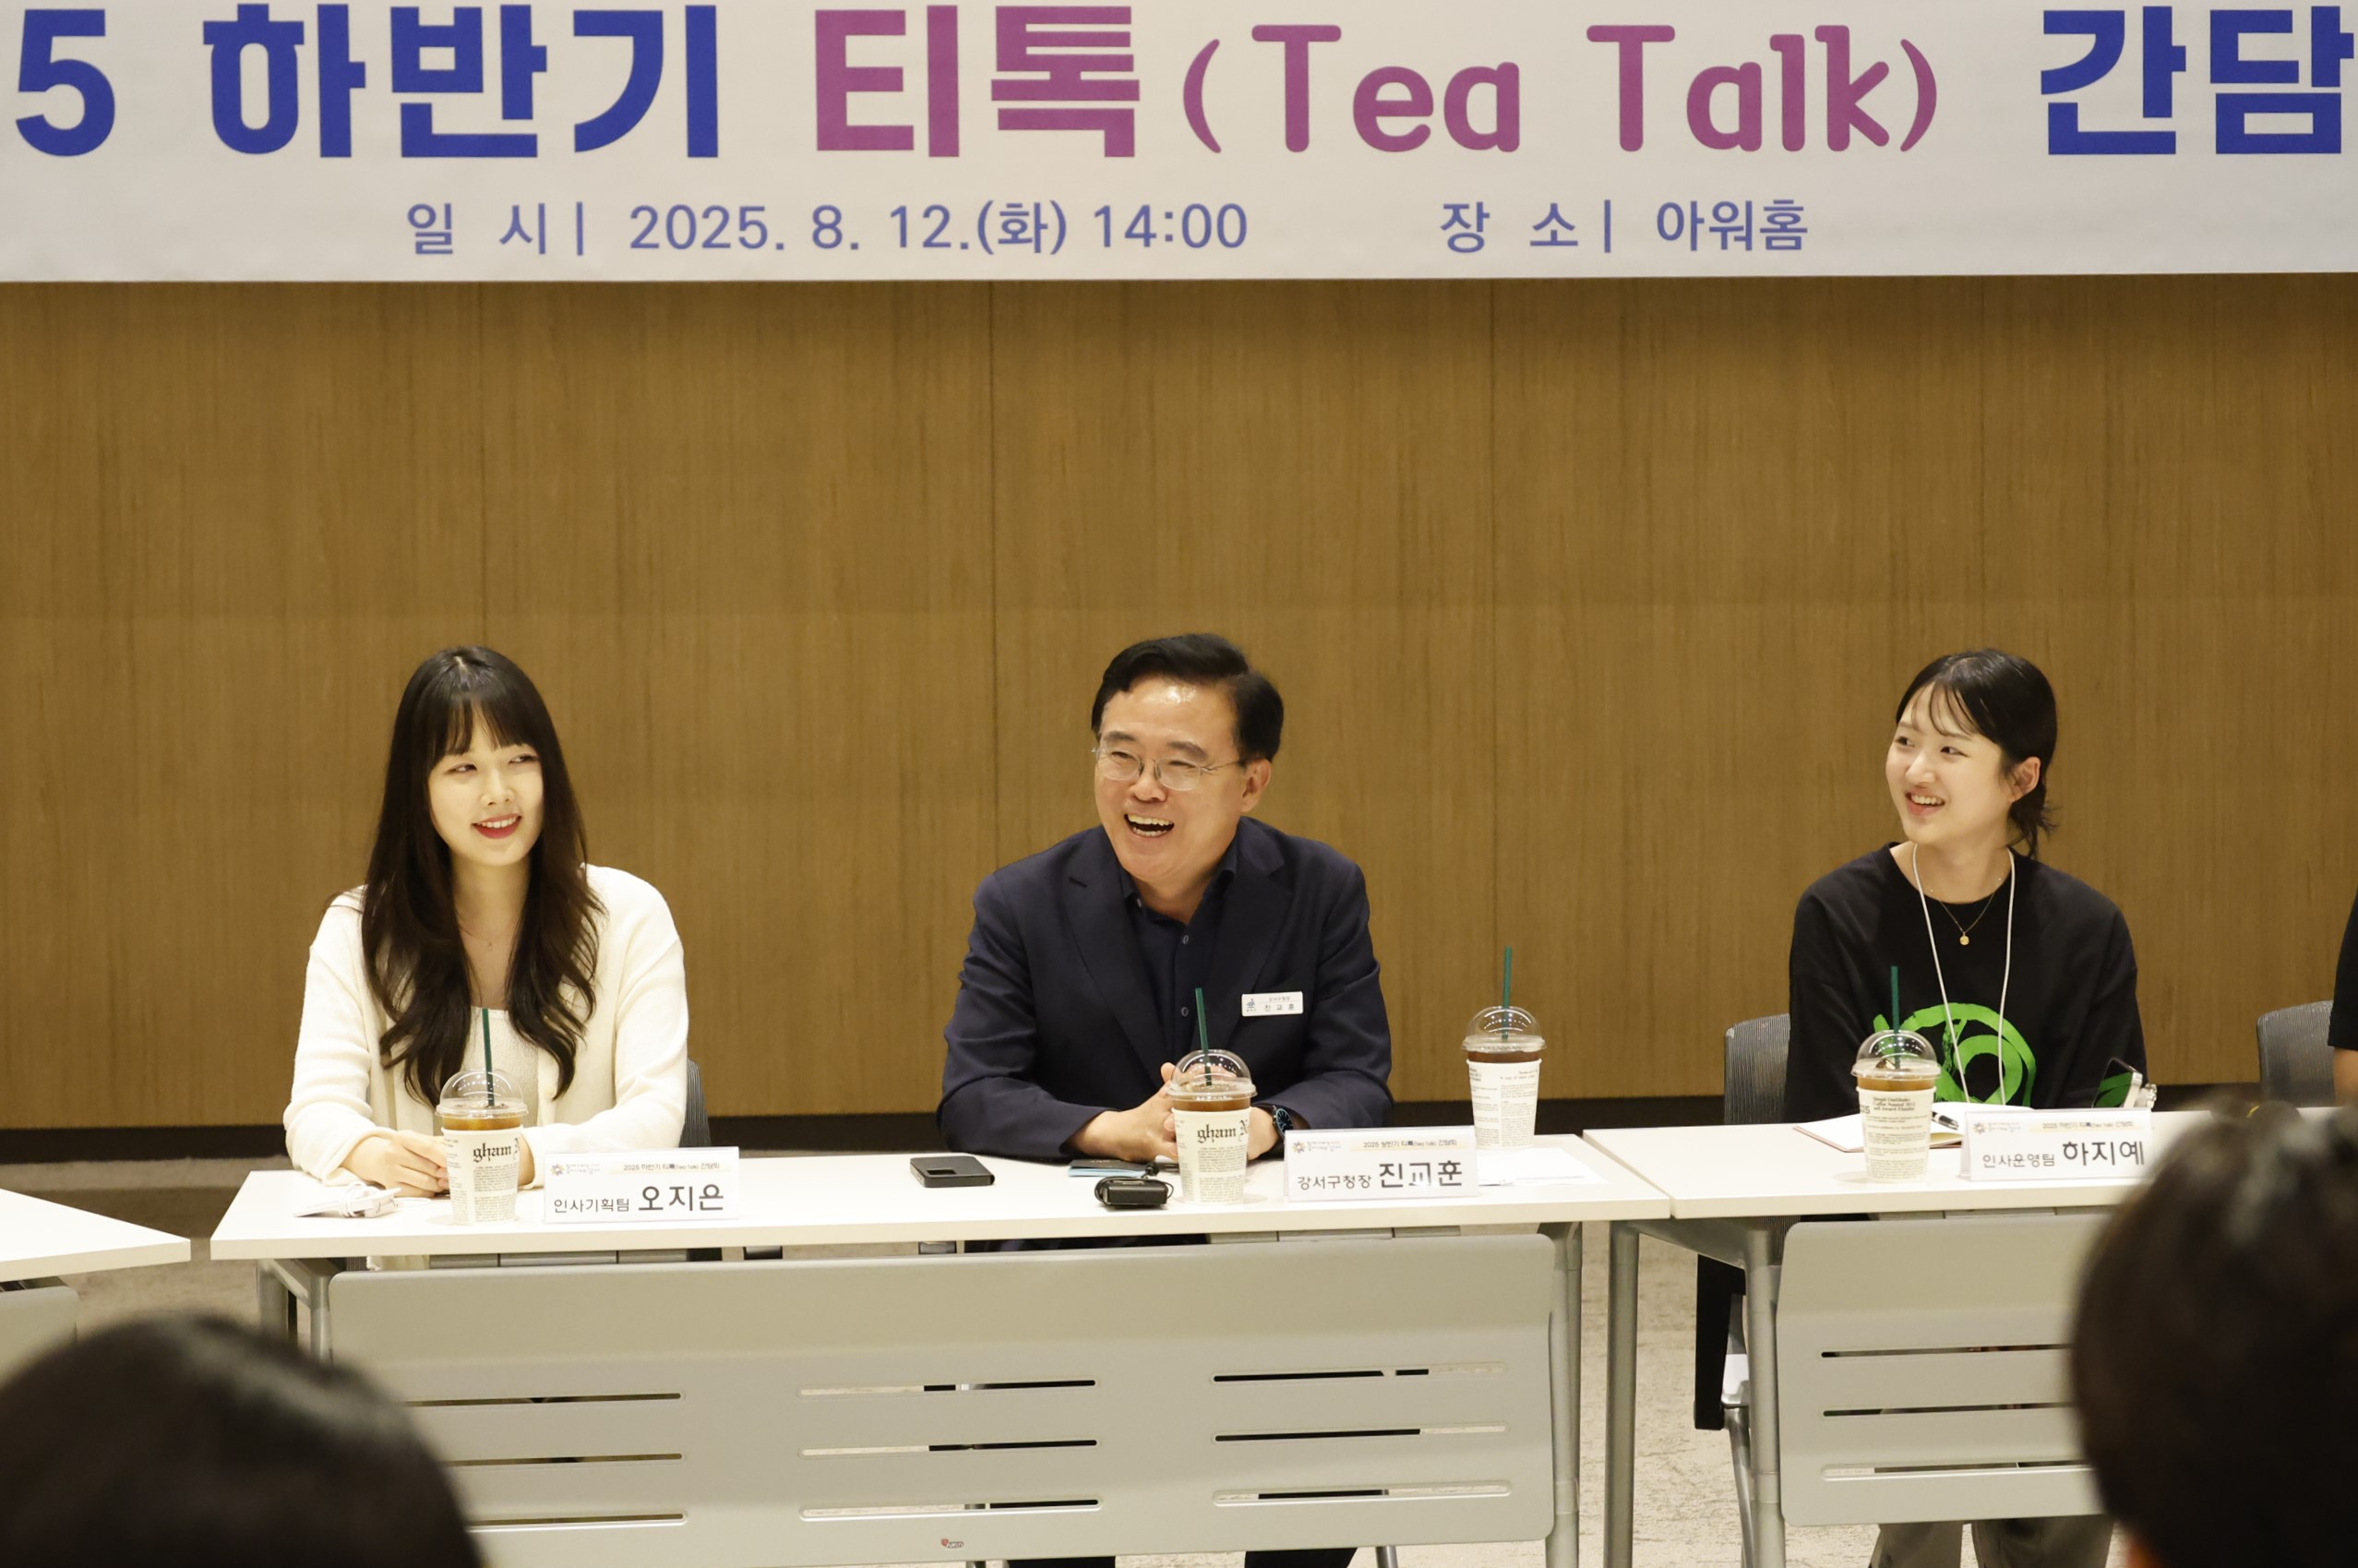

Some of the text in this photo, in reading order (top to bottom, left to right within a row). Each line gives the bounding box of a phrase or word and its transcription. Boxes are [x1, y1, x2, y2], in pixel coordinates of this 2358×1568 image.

[203, 4, 718, 158] 하반기
[1586, 25, 1936, 153] Talk)
[2041, 6, 2355, 155] 간담
[408, 204, 452, 254] 일
[631, 205, 784, 250] 2025.
[813, 205, 859, 250] 8.
[1095, 204, 1247, 249] 14:00
[1442, 202, 1490, 253] 장
[1658, 199, 1808, 251] 아워홈
[1982, 1142, 2145, 1168] 인사운영팀 하지예
[1298, 1160, 1463, 1191] 강서구청장 진교훈
[554, 1183, 724, 1214] 인사기획팀 오지은
